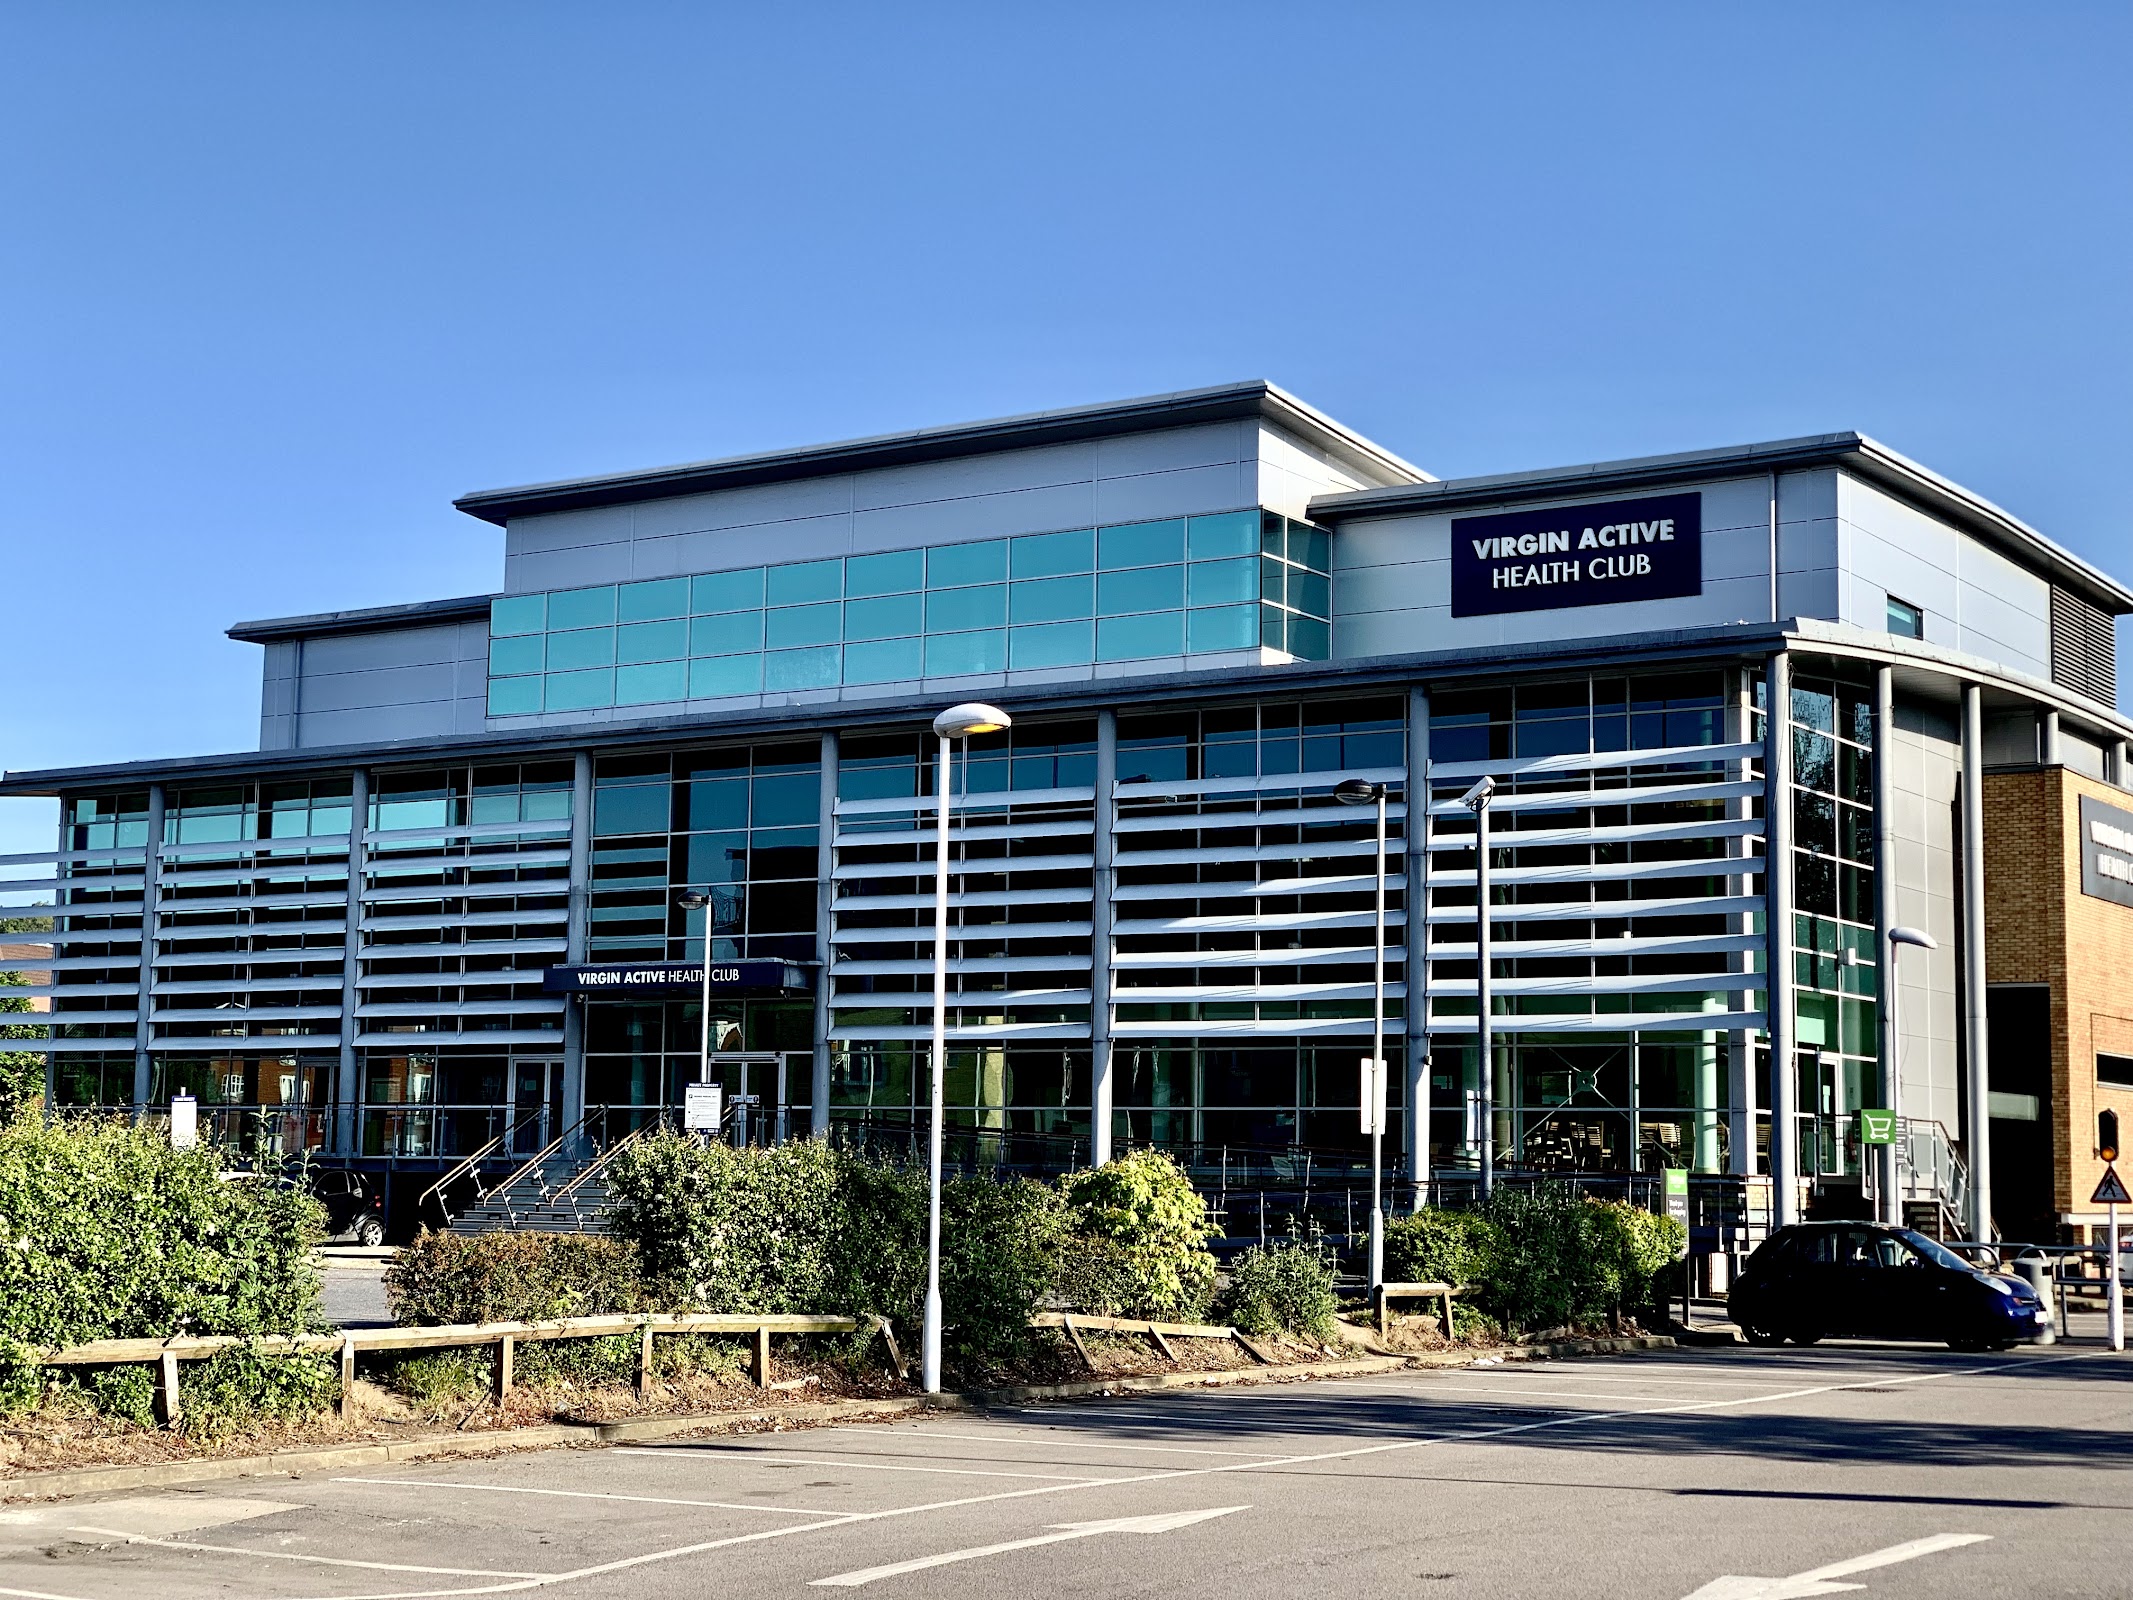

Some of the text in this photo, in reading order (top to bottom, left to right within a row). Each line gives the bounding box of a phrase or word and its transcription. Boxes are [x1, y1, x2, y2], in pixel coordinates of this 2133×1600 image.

[1472, 519, 1674, 559] VIRGIN ACTIVE
[1492, 553, 1652, 589] HEALTH CLUB
[577, 971, 620, 985] VIRGIN
[624, 970, 666, 984] ACTIVE
[711, 968, 740, 982] CLUB
